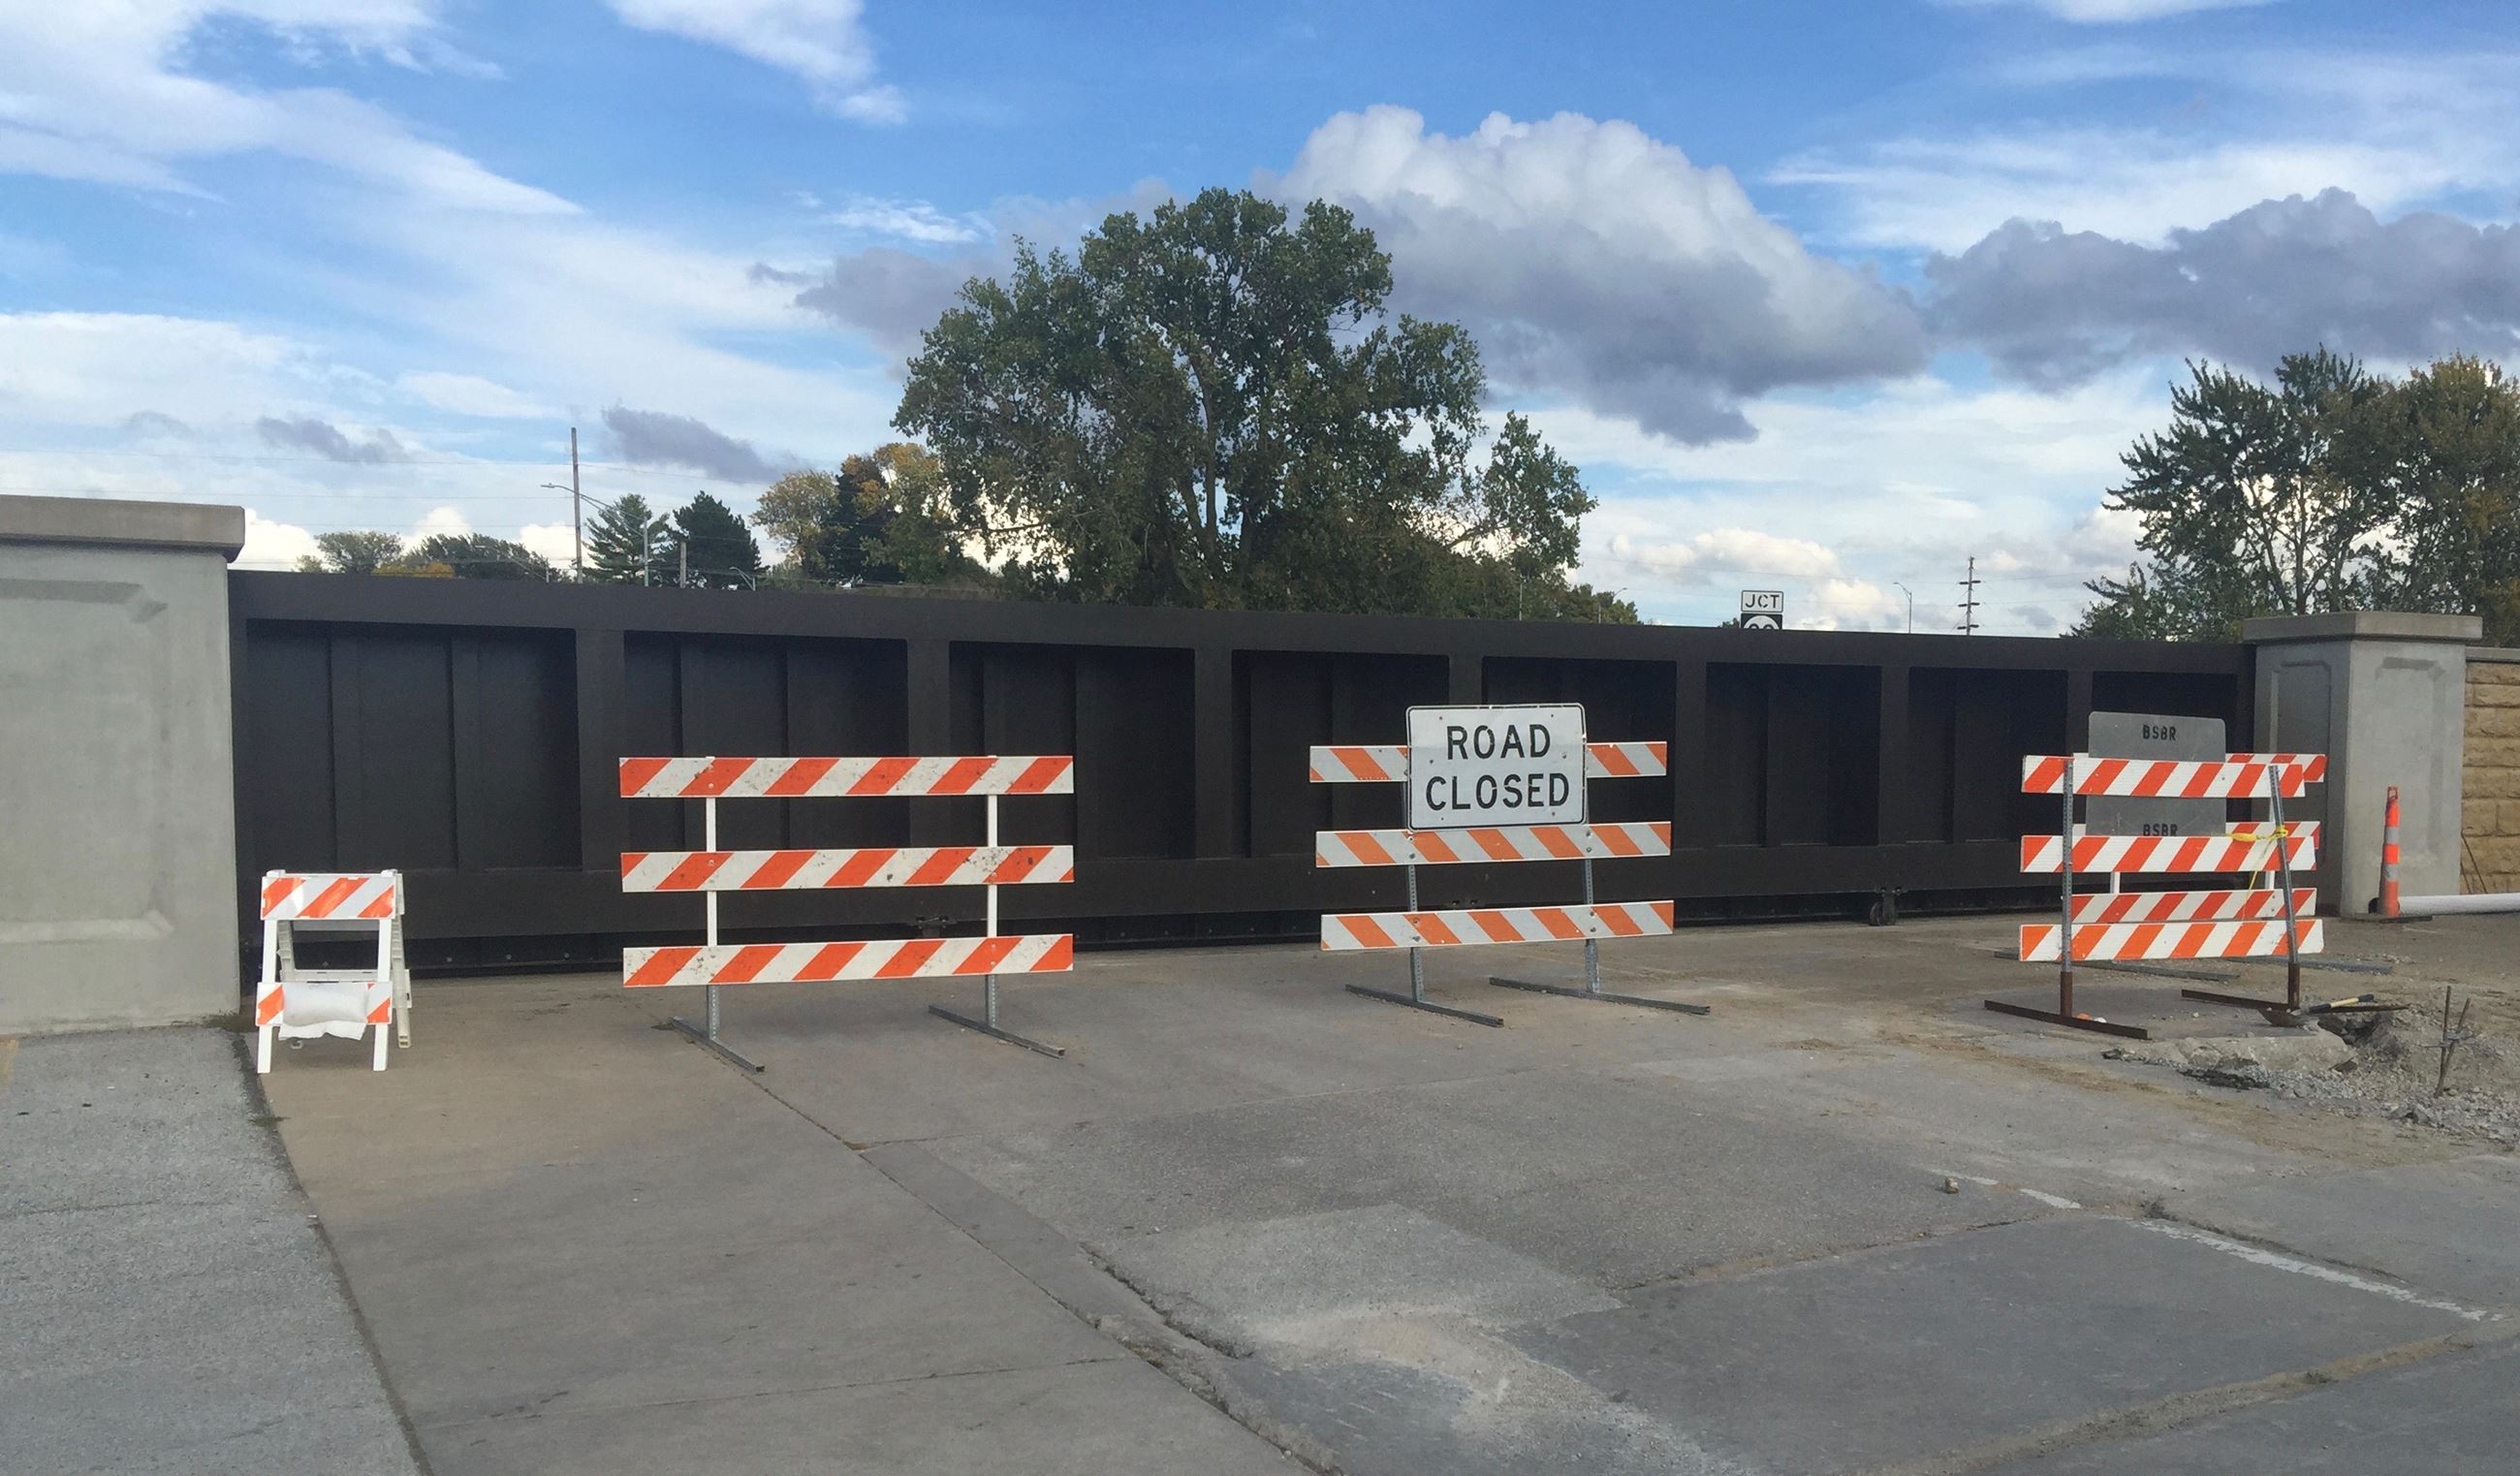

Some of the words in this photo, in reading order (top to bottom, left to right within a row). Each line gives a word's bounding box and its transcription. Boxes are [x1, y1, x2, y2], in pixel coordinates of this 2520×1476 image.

[1745, 594, 1780, 609] JCT
[2143, 725, 2177, 741] BSBR
[1446, 724, 1551, 760] ROAD
[1426, 772, 1570, 811] CLOSED
[2143, 823, 2178, 836] BSBR
